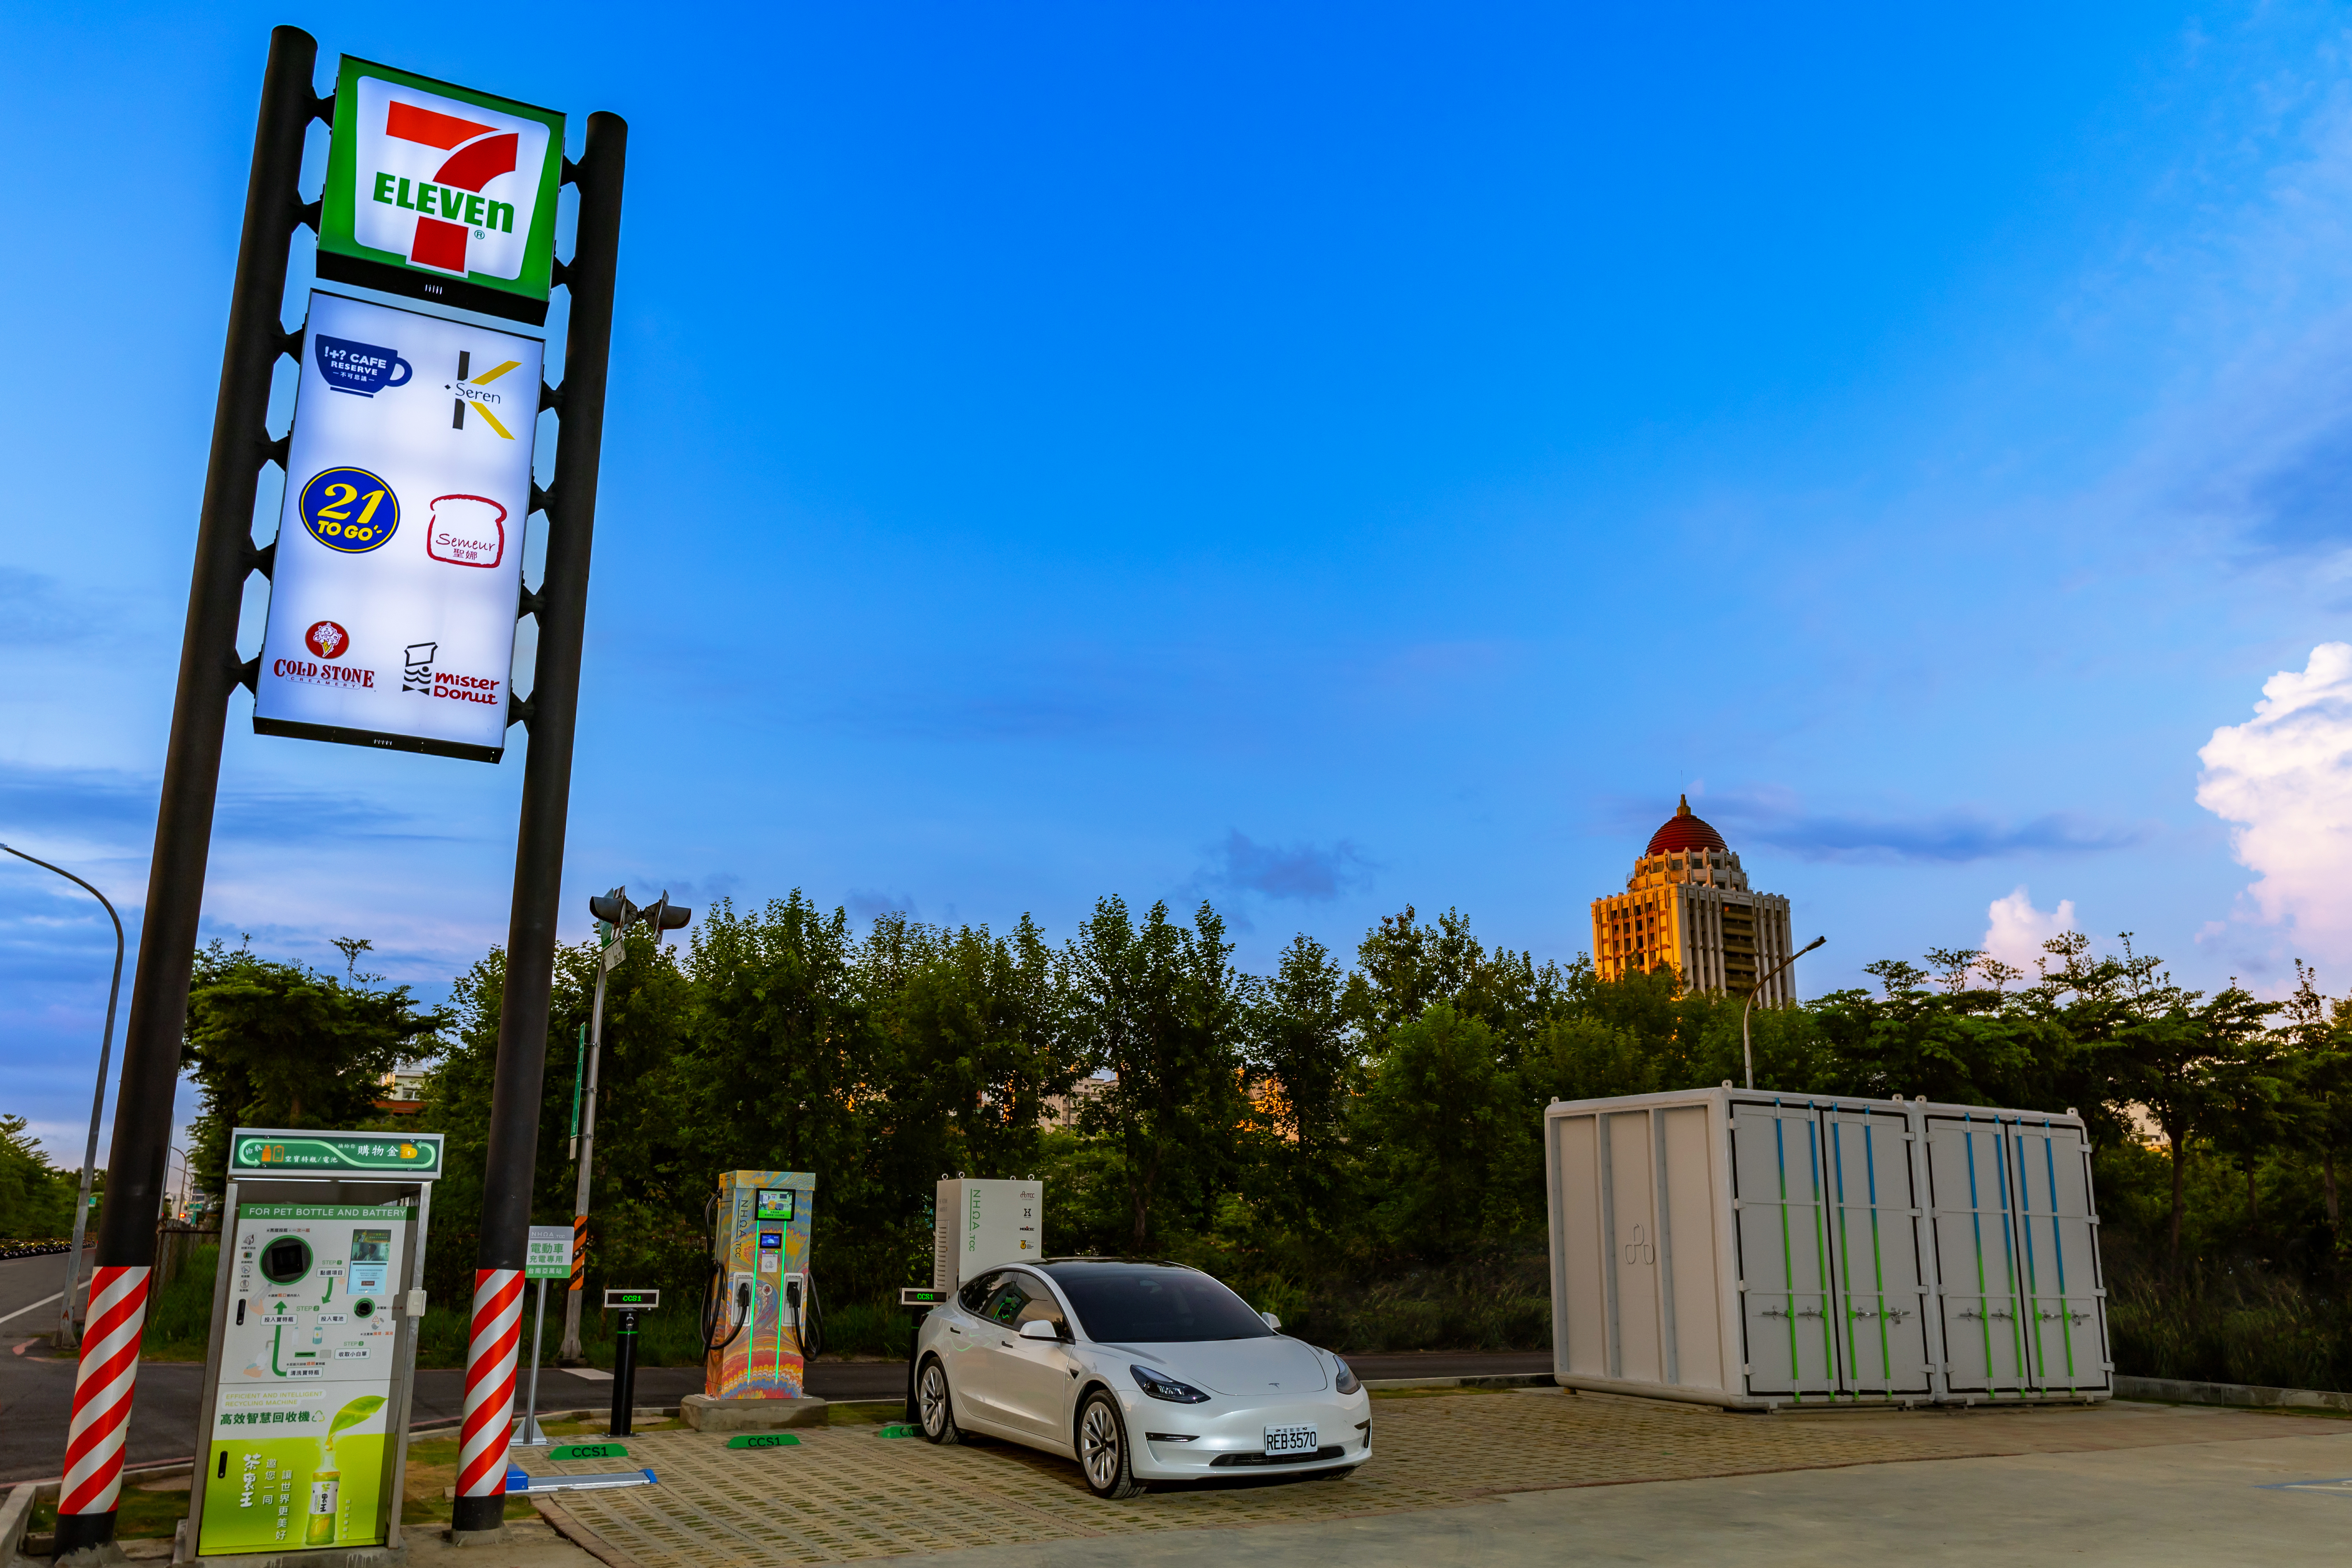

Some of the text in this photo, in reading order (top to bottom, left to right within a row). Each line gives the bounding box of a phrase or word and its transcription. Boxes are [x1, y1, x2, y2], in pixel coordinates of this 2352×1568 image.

[373, 172, 514, 234] ELEVEn
[331, 361, 378, 376] RESERVE
[350, 353, 387, 369] CAFE
[340, 372, 367, 382] 不可思議
[455, 383, 501, 404] Seren
[317, 483, 385, 524] 21
[317, 520, 373, 541] TO GO
[436, 534, 496, 552] Semeur
[453, 548, 477, 560] 聖娜
[274, 659, 374, 688] COLD STONE
[291, 676, 355, 688] CREAMERY
[433, 685, 498, 705] Donut
[357, 1145, 398, 1157] 購物金
[296, 1208, 334, 1216] BOTTLE
[362, 1209, 407, 1217] BATTERY
[531, 1243, 564, 1254] 電動車
[529, 1255, 563, 1263] 充電專用
[220, 1410, 310, 1425] 高效智慧回收機
[900, 1426, 924, 1437] CCS
[748, 1437, 779, 1447] CCS1
[572, 1446, 609, 1457] CCS1
[262, 1458, 277, 1505] 邀您一同
[275, 1469, 293, 1540] 讓世界更美好
